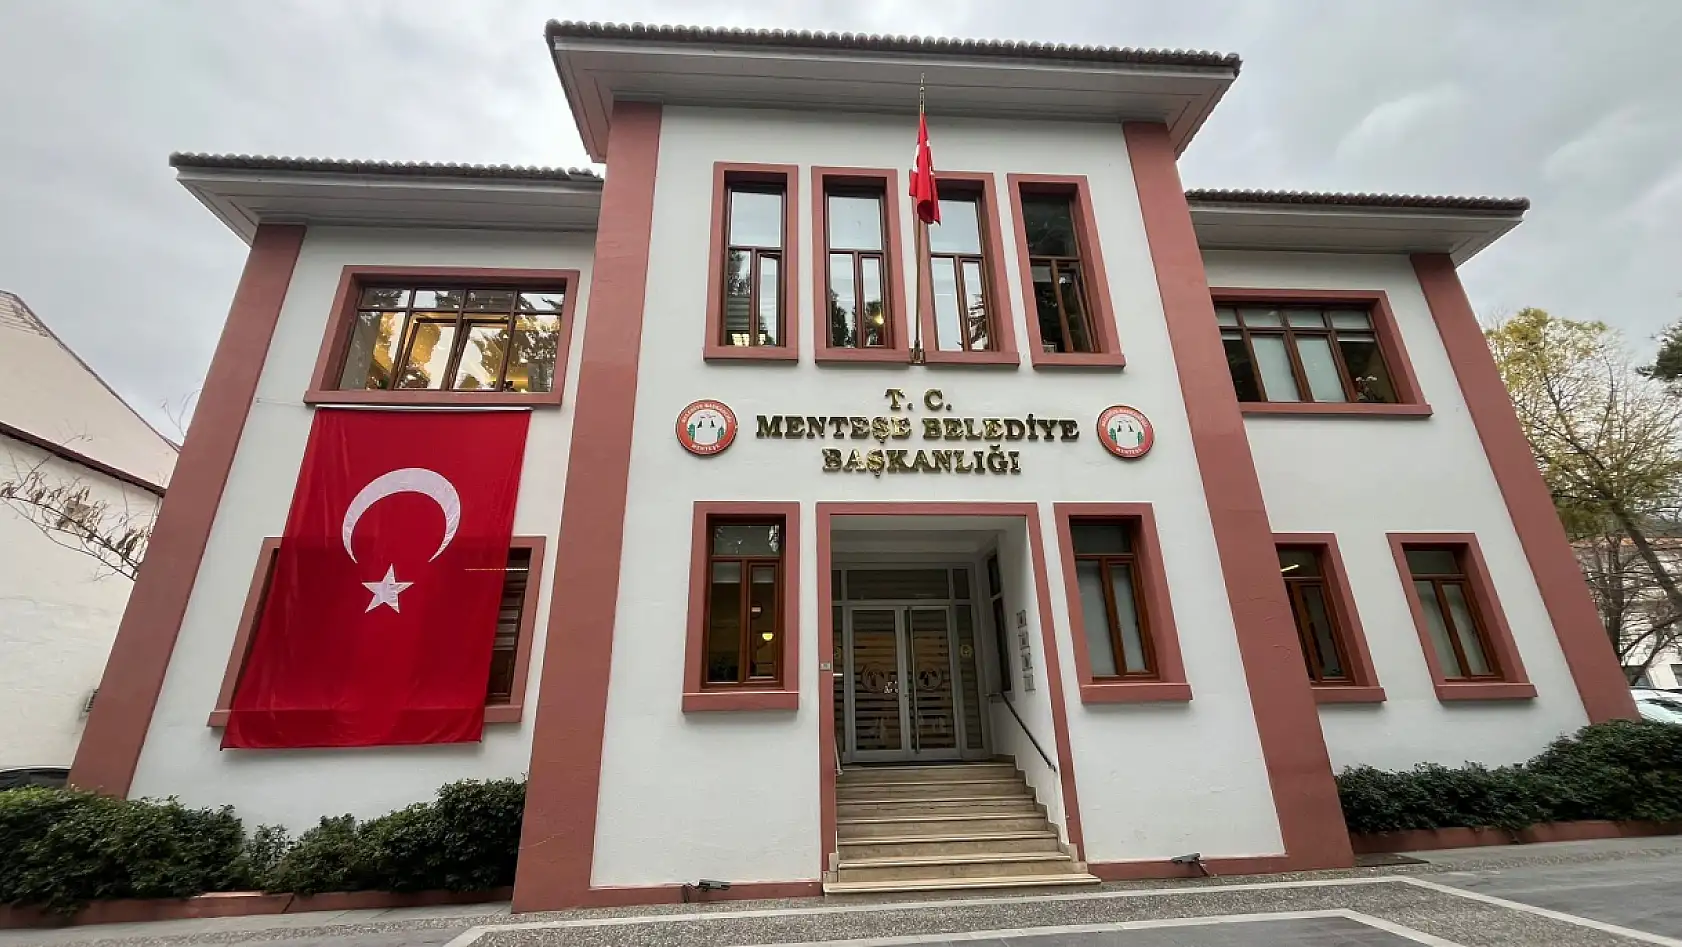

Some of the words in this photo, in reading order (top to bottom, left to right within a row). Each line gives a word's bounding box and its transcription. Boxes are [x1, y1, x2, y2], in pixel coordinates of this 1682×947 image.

[884, 388, 914, 410] T.
[923, 388, 952, 411] C.
[756, 415, 912, 443] MENTEŞE
[922, 413, 1080, 442] BELEDİYE
[821, 444, 1021, 478] BAŞKANLIĞI
